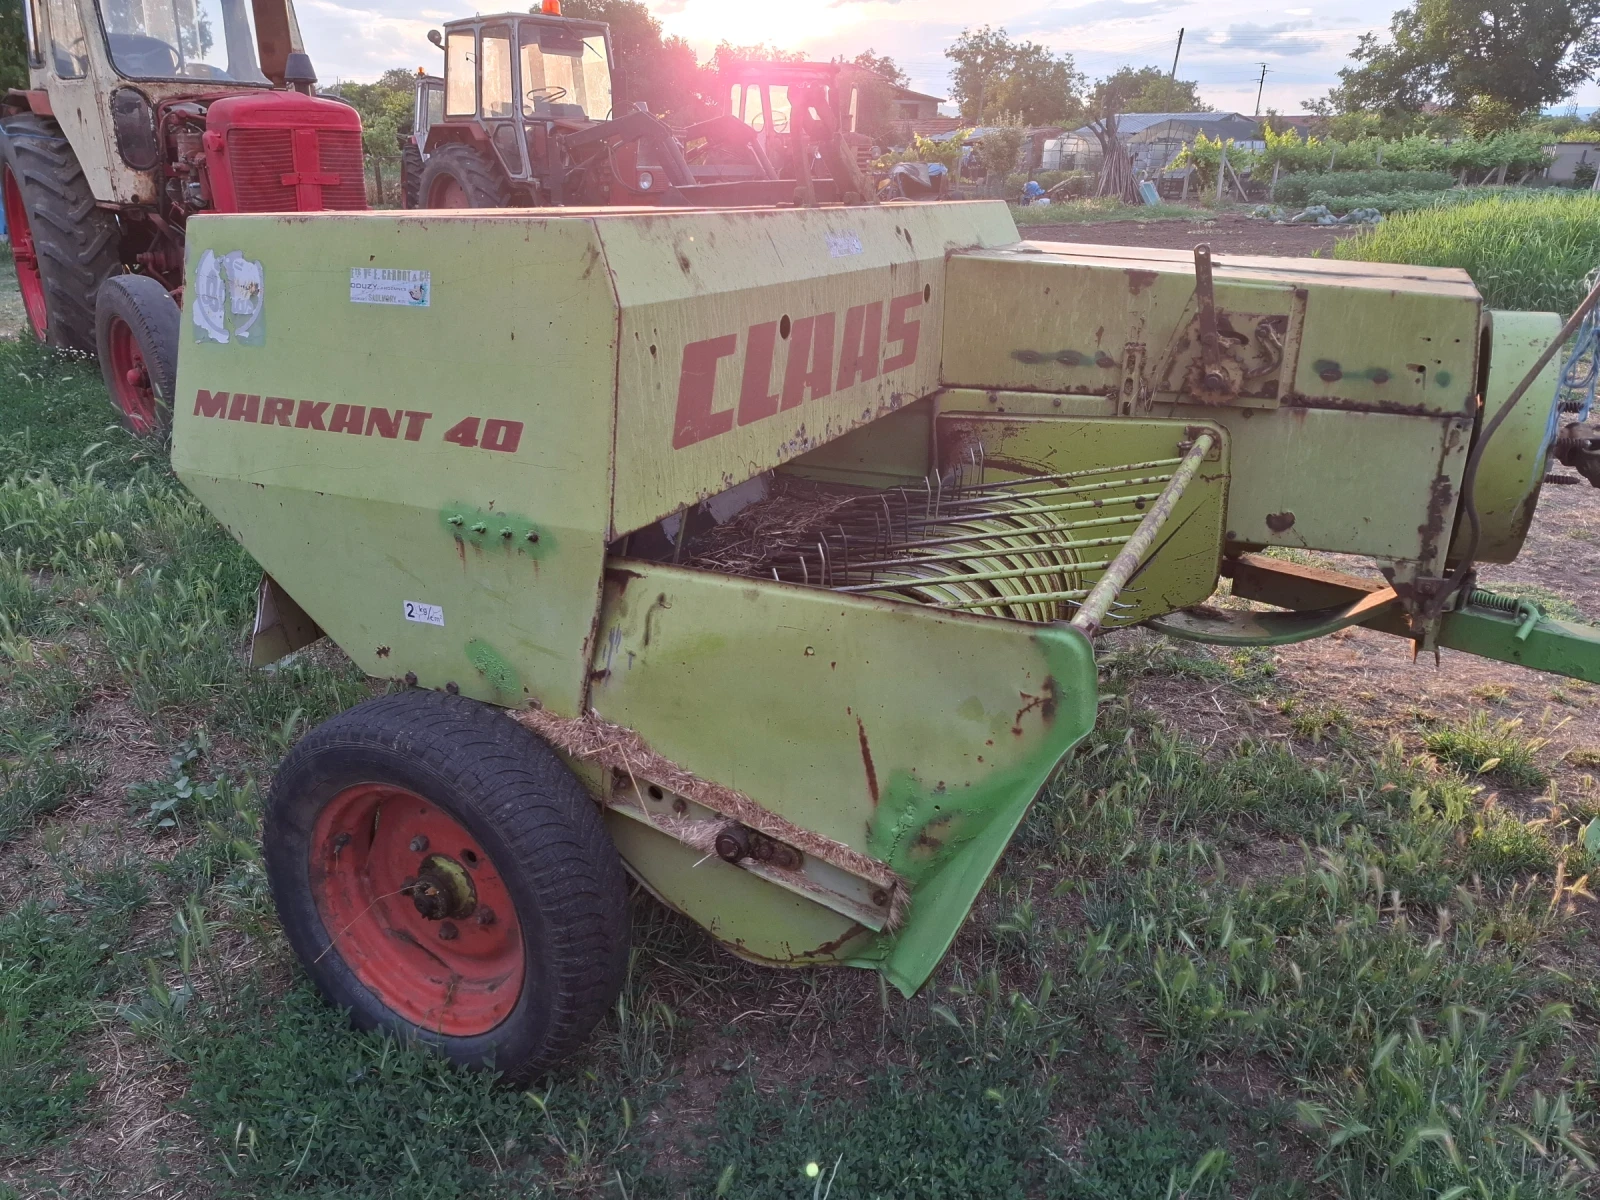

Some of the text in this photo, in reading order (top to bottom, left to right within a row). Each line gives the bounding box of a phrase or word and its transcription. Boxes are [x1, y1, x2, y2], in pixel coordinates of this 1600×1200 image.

[672, 291, 924, 451] CLAAS
[193, 389, 524, 453] MARKANT 40
[406, 603, 415, 618] 2
